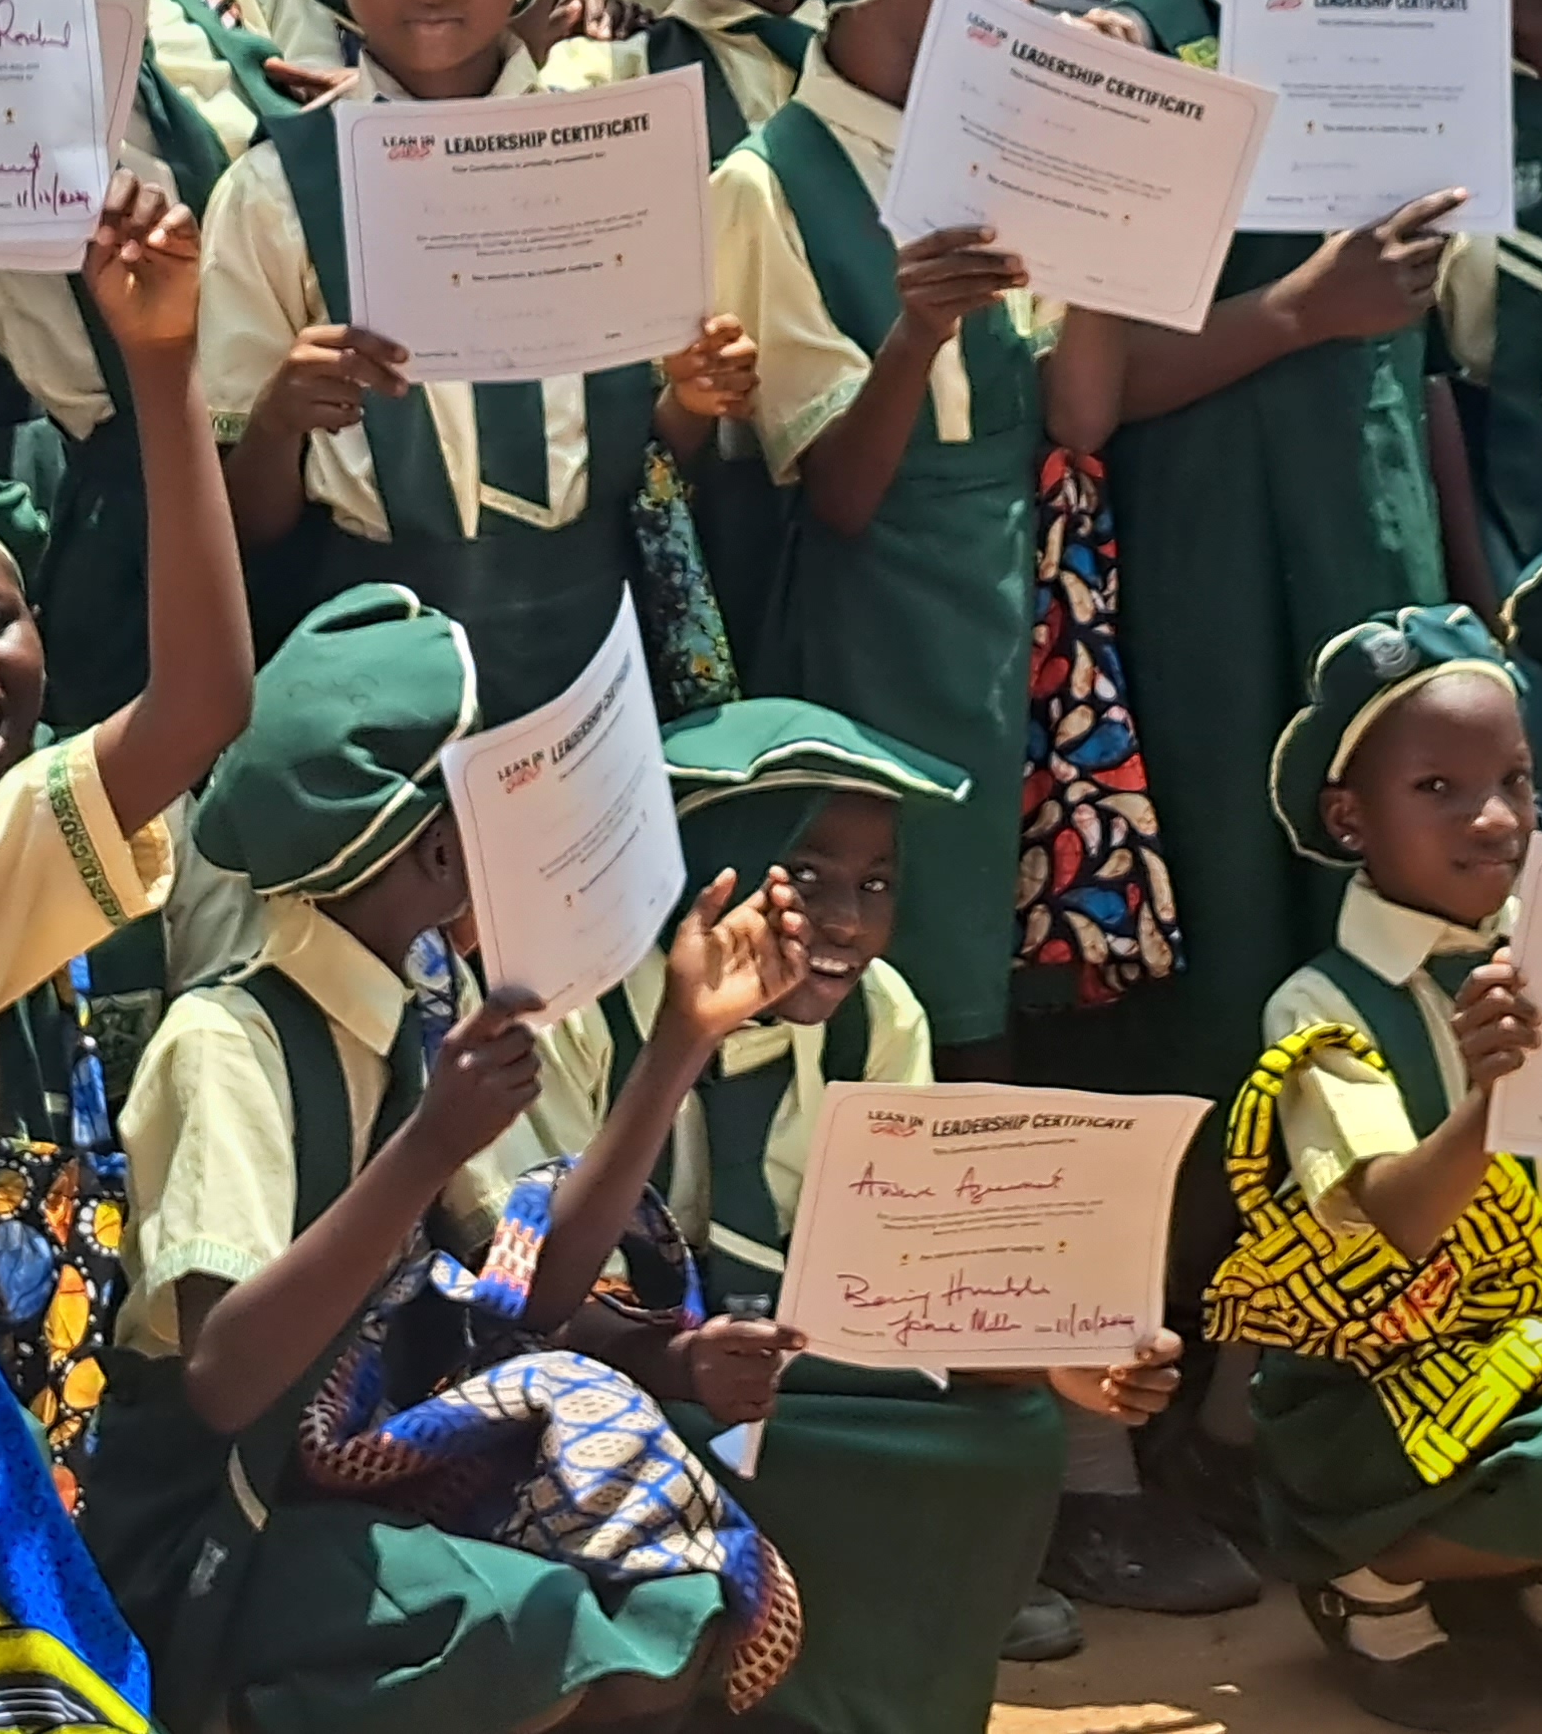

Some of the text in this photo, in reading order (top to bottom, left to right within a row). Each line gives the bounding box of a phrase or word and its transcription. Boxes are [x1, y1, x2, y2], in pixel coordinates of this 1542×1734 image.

[1011, 39, 1104, 89] LEADERSHIP
[1106, 76, 1205, 122] CERTIFICATE
[444, 113, 650, 156] LEADERSHIP CERTIFICATE
[931, 1113, 1137, 1137] LEADERSHIP CERTIFICATE
